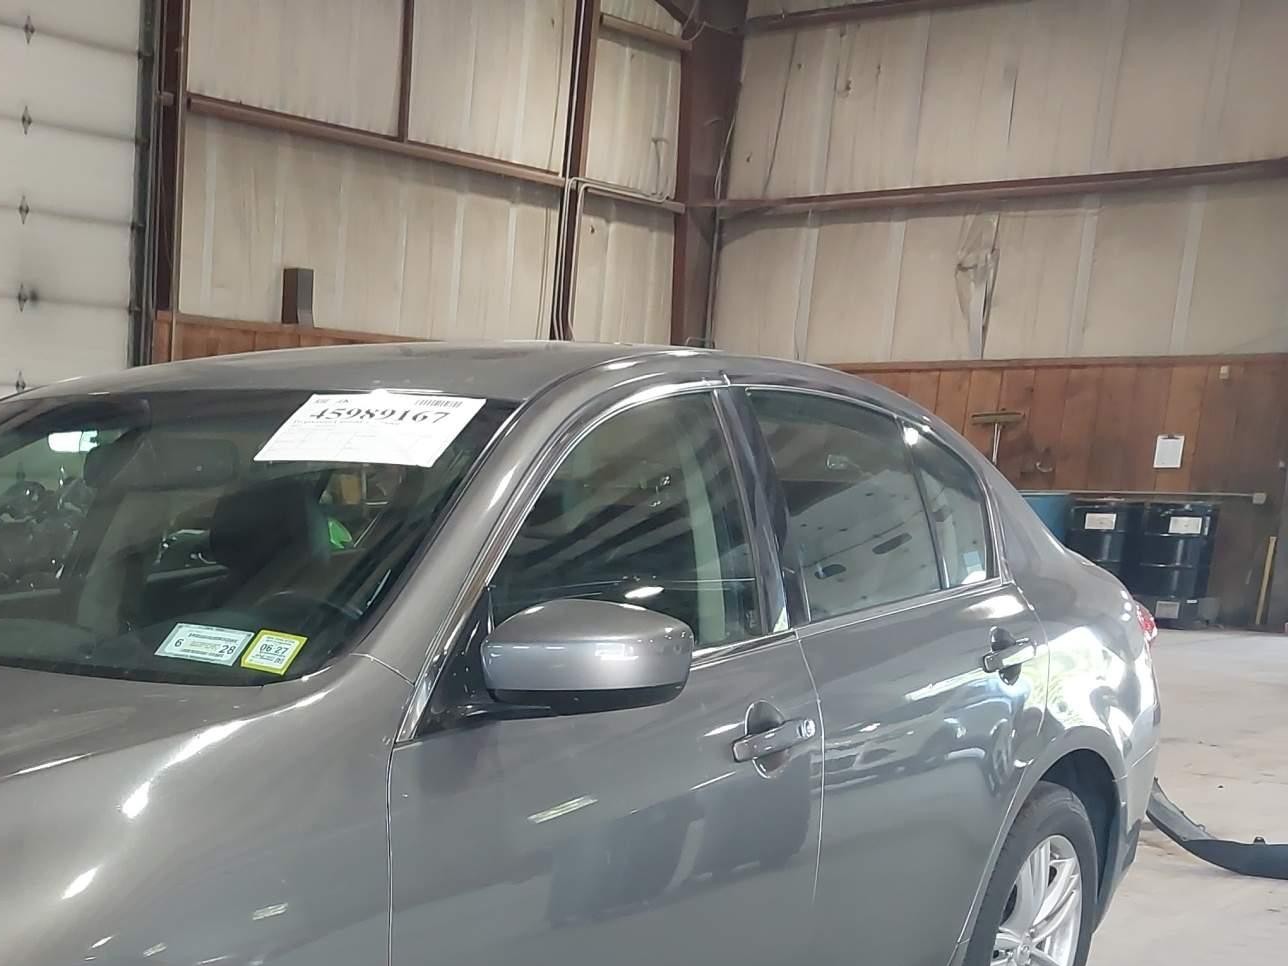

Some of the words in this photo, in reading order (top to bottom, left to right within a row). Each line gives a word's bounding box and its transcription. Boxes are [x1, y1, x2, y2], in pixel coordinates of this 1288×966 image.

[310, 407, 451, 424] 45989167
[174, 638, 185, 648] 6
[218, 644, 237, 655] 28
[274, 646, 290, 655] 27
